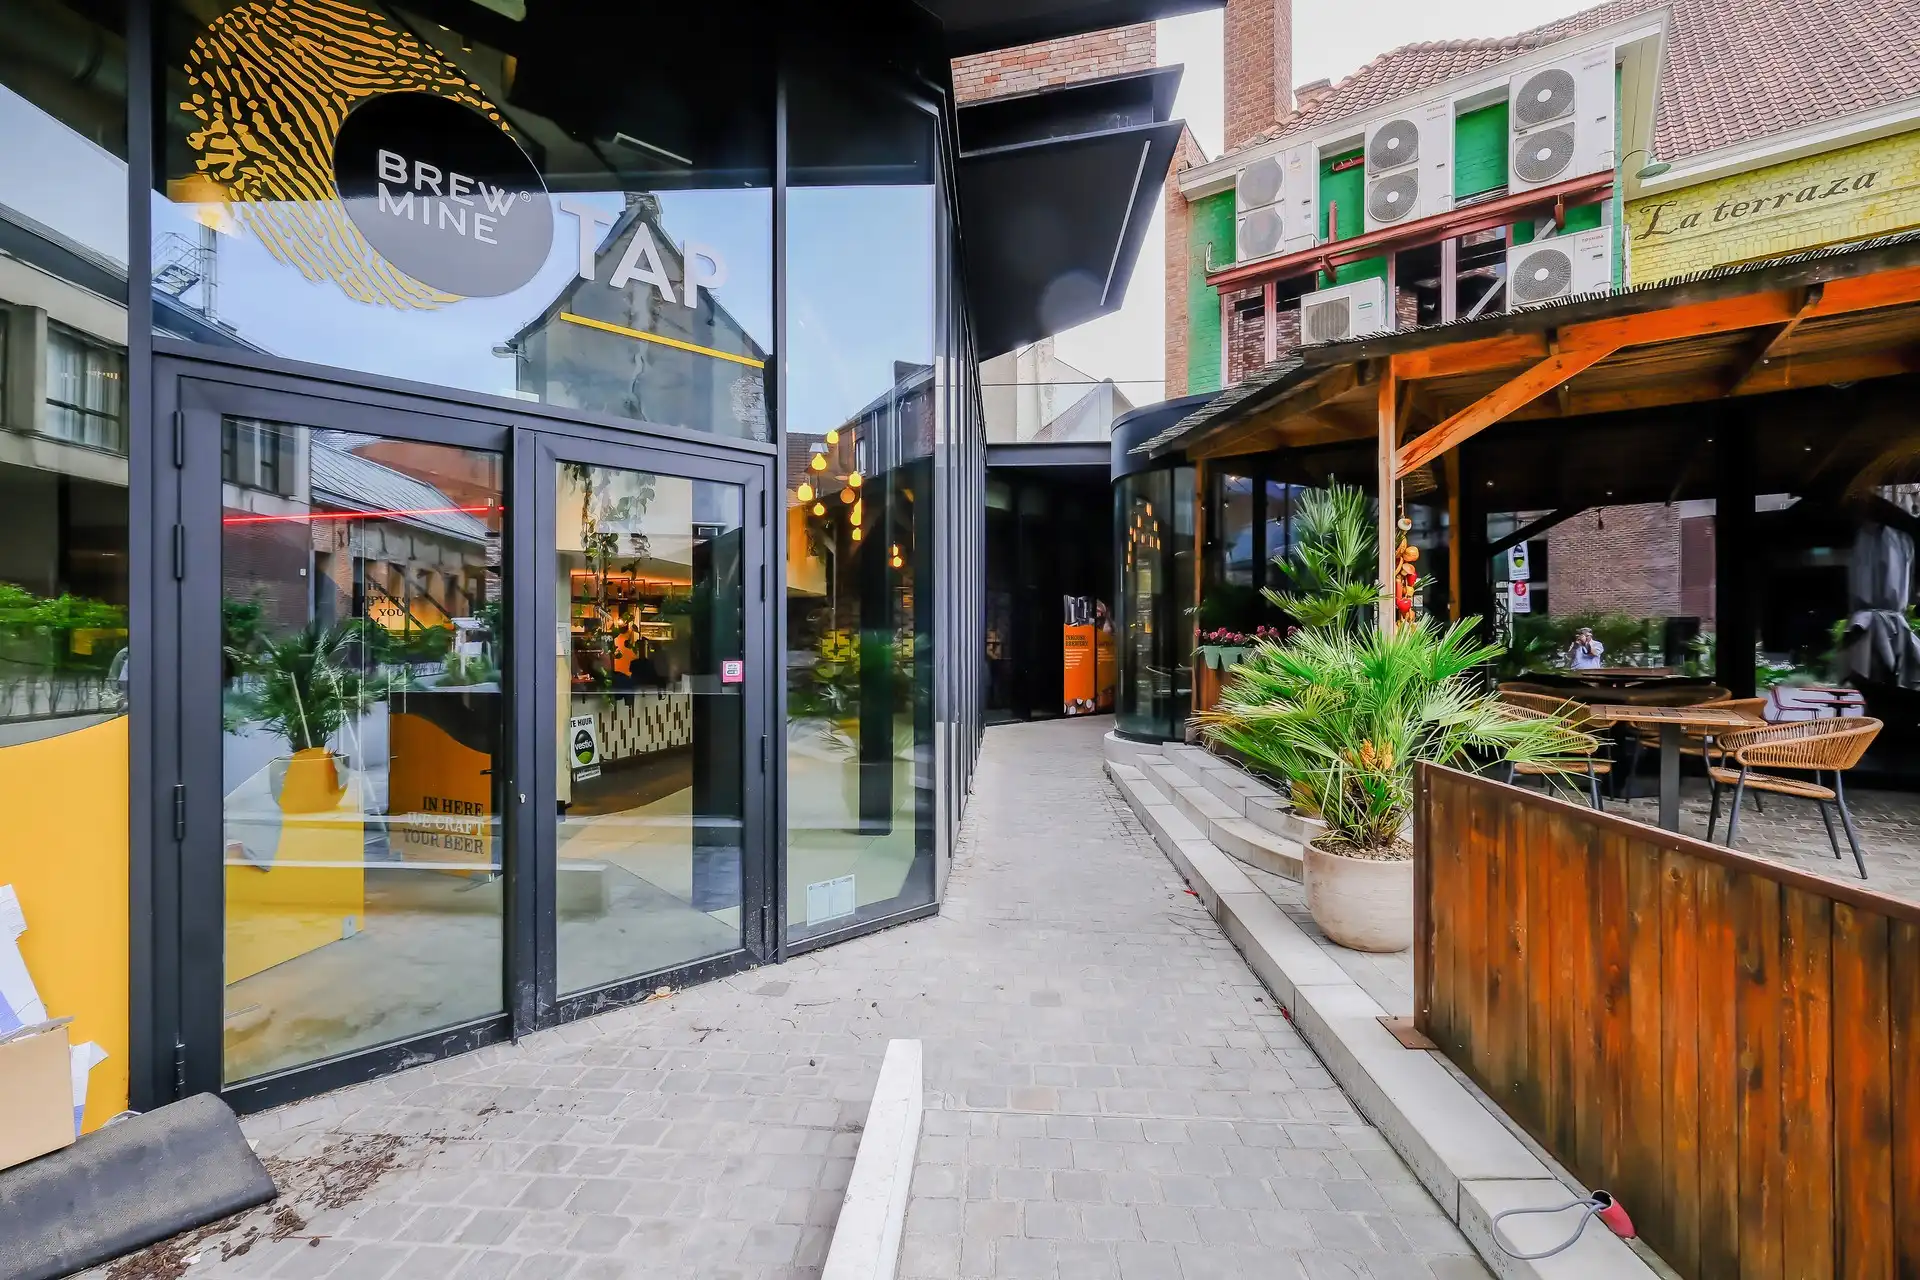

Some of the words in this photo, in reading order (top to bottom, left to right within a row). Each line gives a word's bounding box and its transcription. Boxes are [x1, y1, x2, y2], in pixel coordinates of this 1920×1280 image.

[378, 149, 517, 217] BREW
[1634, 200, 1702, 241] La
[1713, 170, 1880, 223] terraza
[378, 182, 498, 245] MINE
[560, 199, 728, 309] TAP
[379, 608, 404, 617] YOU
[407, 811, 431, 828] WE
[435, 814, 485, 837] CRAFT
[423, 796, 438, 812] IN
[441, 798, 484, 818] HERE
[402, 827, 440, 848] YOUR
[444, 834, 485, 854] BEER
